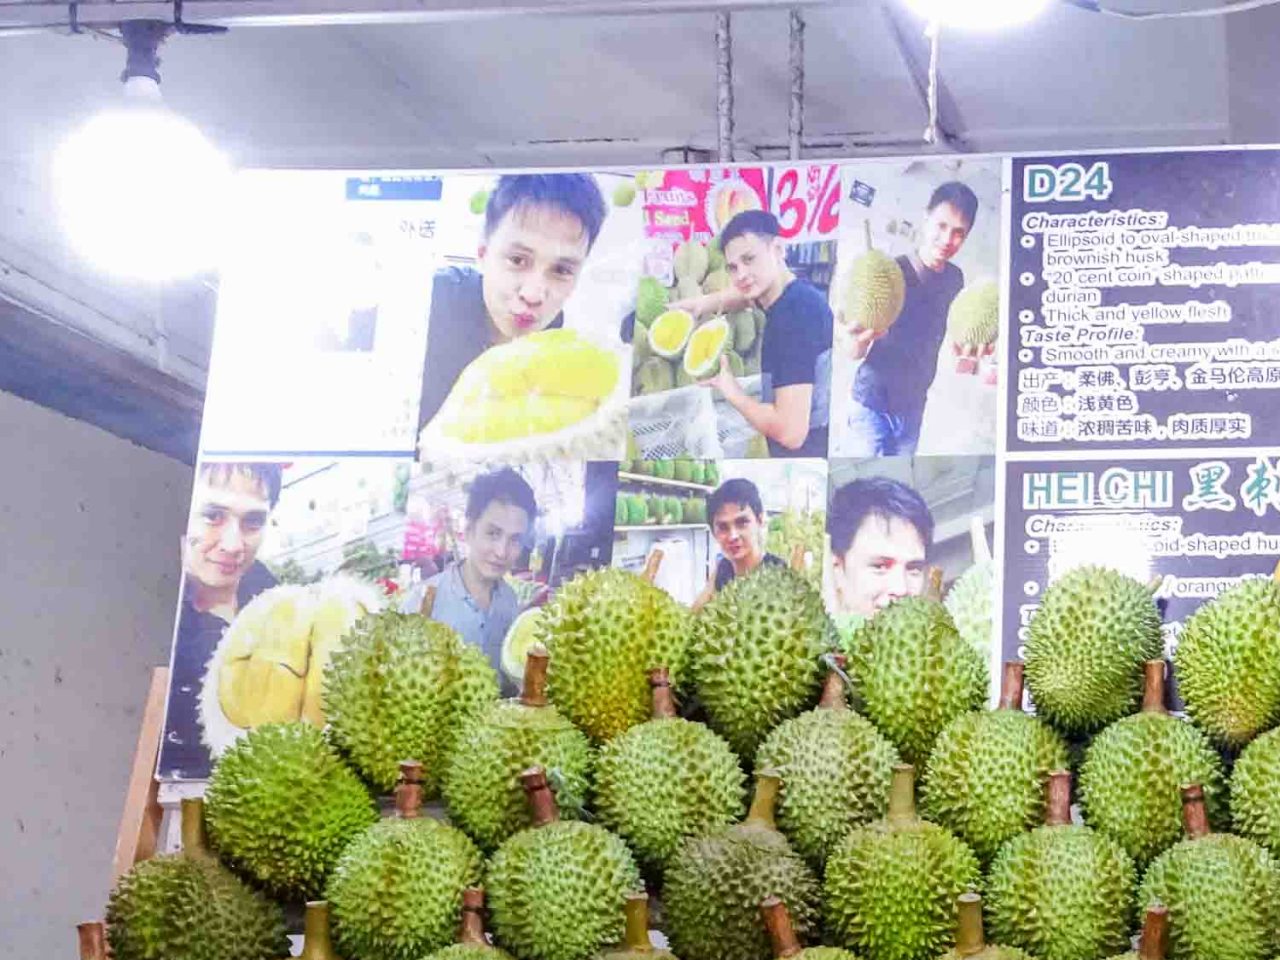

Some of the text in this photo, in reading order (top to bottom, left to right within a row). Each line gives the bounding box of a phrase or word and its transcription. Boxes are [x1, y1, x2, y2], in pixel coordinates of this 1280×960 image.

[1026, 165, 1110, 200] D24
[1026, 213, 1165, 232] Characteristics:
[1048, 232, 1115, 251] Ellipsoid
[1121, 233, 1135, 246] to
[1141, 229, 1241, 248] oval-shaped
[1047, 250, 1164, 266] brownish husk
[1078, 270, 1113, 284] cent
[1164, 267, 1223, 285] shaped
[1047, 289, 1097, 304] durian
[1047, 304, 1227, 324] Thick and yellow flesh
[1025, 327, 1139, 344] Taste Profile:
[1046, 347, 1109, 362] Smooth
[1115, 346, 1145, 361] and
[1150, 347, 1210, 363] creamy
[1217, 343, 1249, 357] with
[1256, 346, 1265, 357] a
[1028, 472, 1090, 506] HEI
[1103, 471, 1170, 506] CHI
